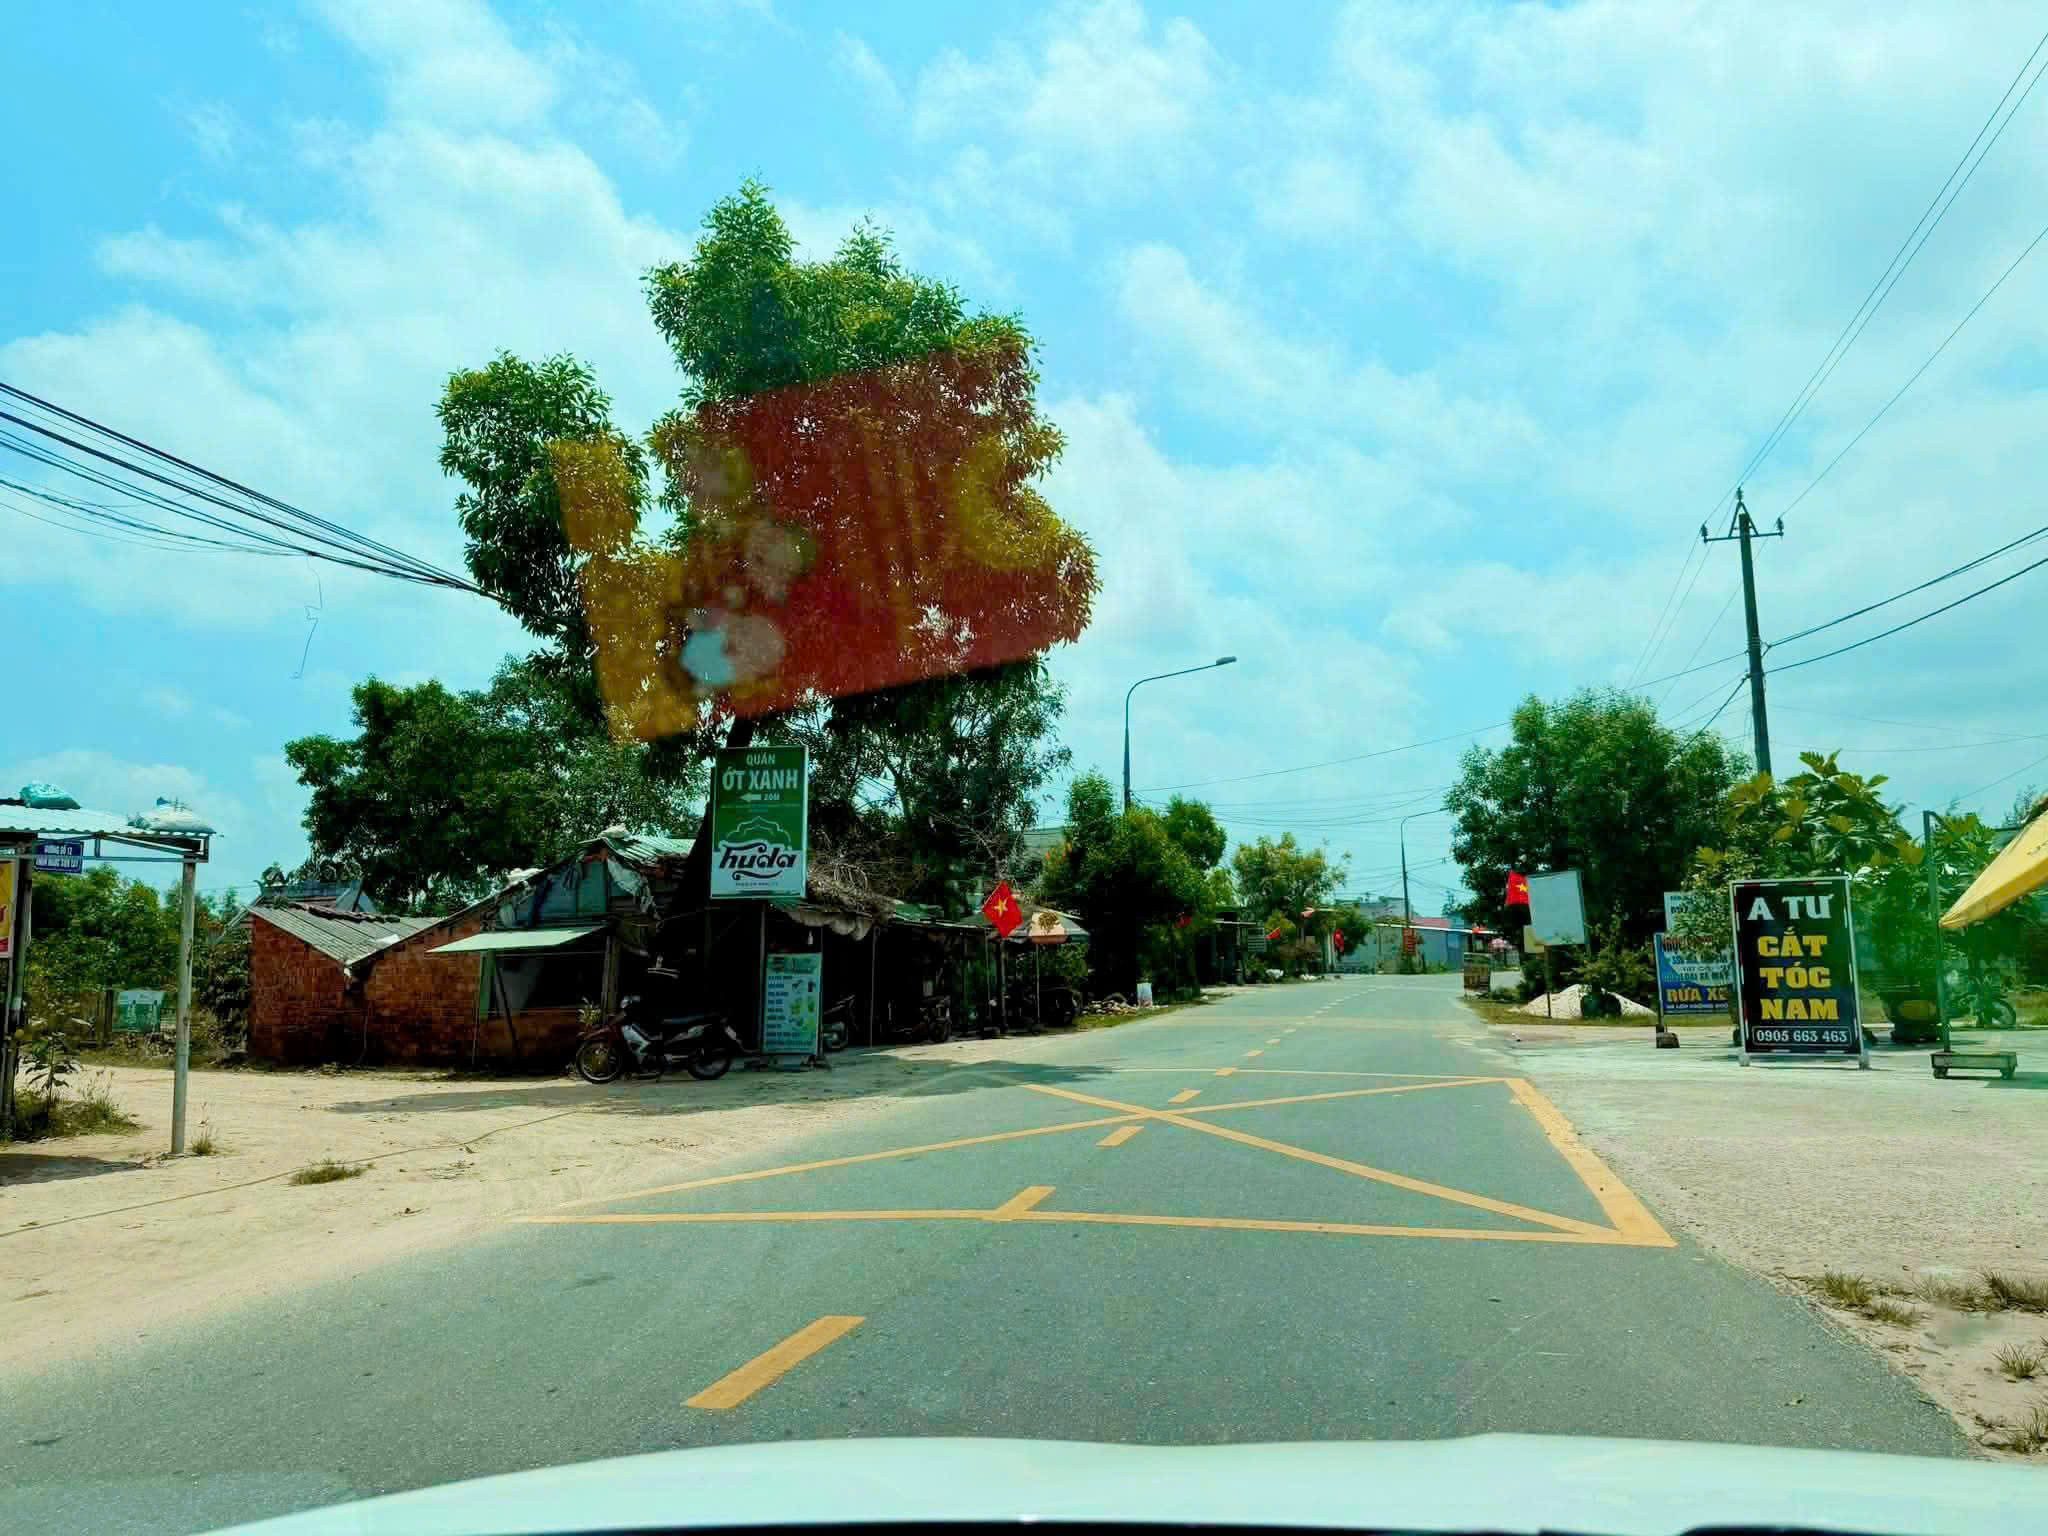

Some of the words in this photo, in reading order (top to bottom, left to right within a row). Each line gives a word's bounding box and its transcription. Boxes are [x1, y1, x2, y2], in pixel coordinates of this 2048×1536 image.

[722, 766, 745, 790] ỚT
[748, 769, 799, 790] XANH
[719, 842, 796, 869] huda
[1747, 897, 1775, 921] A
[1781, 893, 1835, 919] TƯ
[1758, 926, 1827, 957] CẮT
[1759, 961, 1832, 989] TÓC
[1760, 998, 1840, 1020] NAM
[1756, 1030, 1789, 1042] 0905
[1793, 1030, 1819, 1042] 663
[1822, 1030, 1848, 1042] 463
